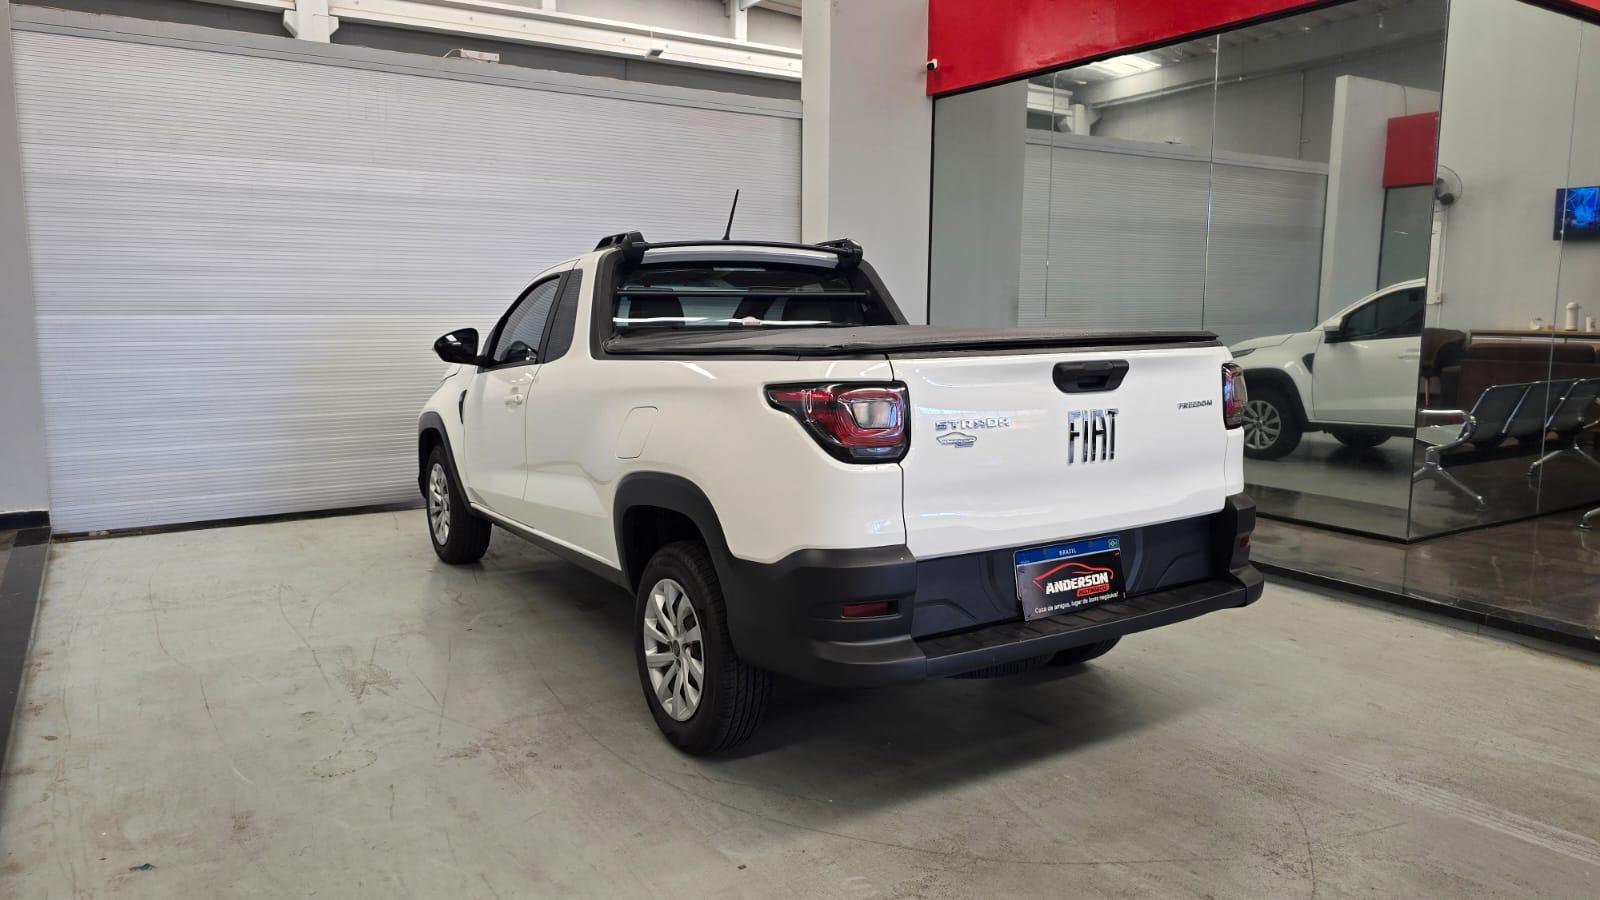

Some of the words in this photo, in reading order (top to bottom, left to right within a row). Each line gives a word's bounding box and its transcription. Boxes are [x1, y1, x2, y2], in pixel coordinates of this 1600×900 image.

[1178, 400, 1213, 409] FREEDOM
[935, 417, 1010, 431] STRADA
[1067, 408, 1119, 465] FIAT
[1046, 572, 1109, 594] ANDERSON
